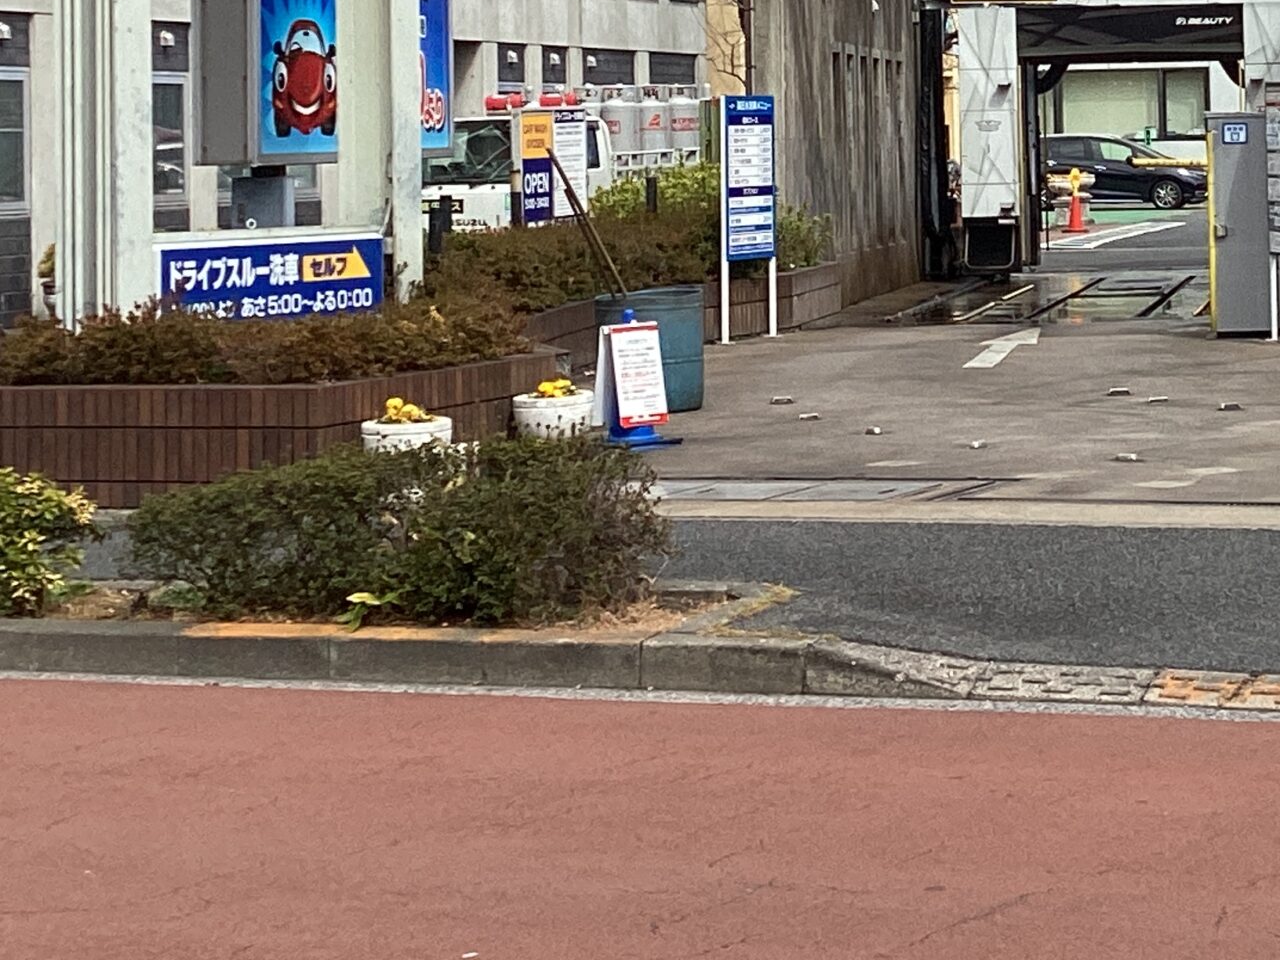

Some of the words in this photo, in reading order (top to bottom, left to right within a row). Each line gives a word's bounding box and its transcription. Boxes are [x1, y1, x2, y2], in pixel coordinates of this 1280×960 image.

[524, 172, 550, 194] OPEN
[452, 219, 488, 227] SUZU
[311, 257, 347, 278] セルフ
